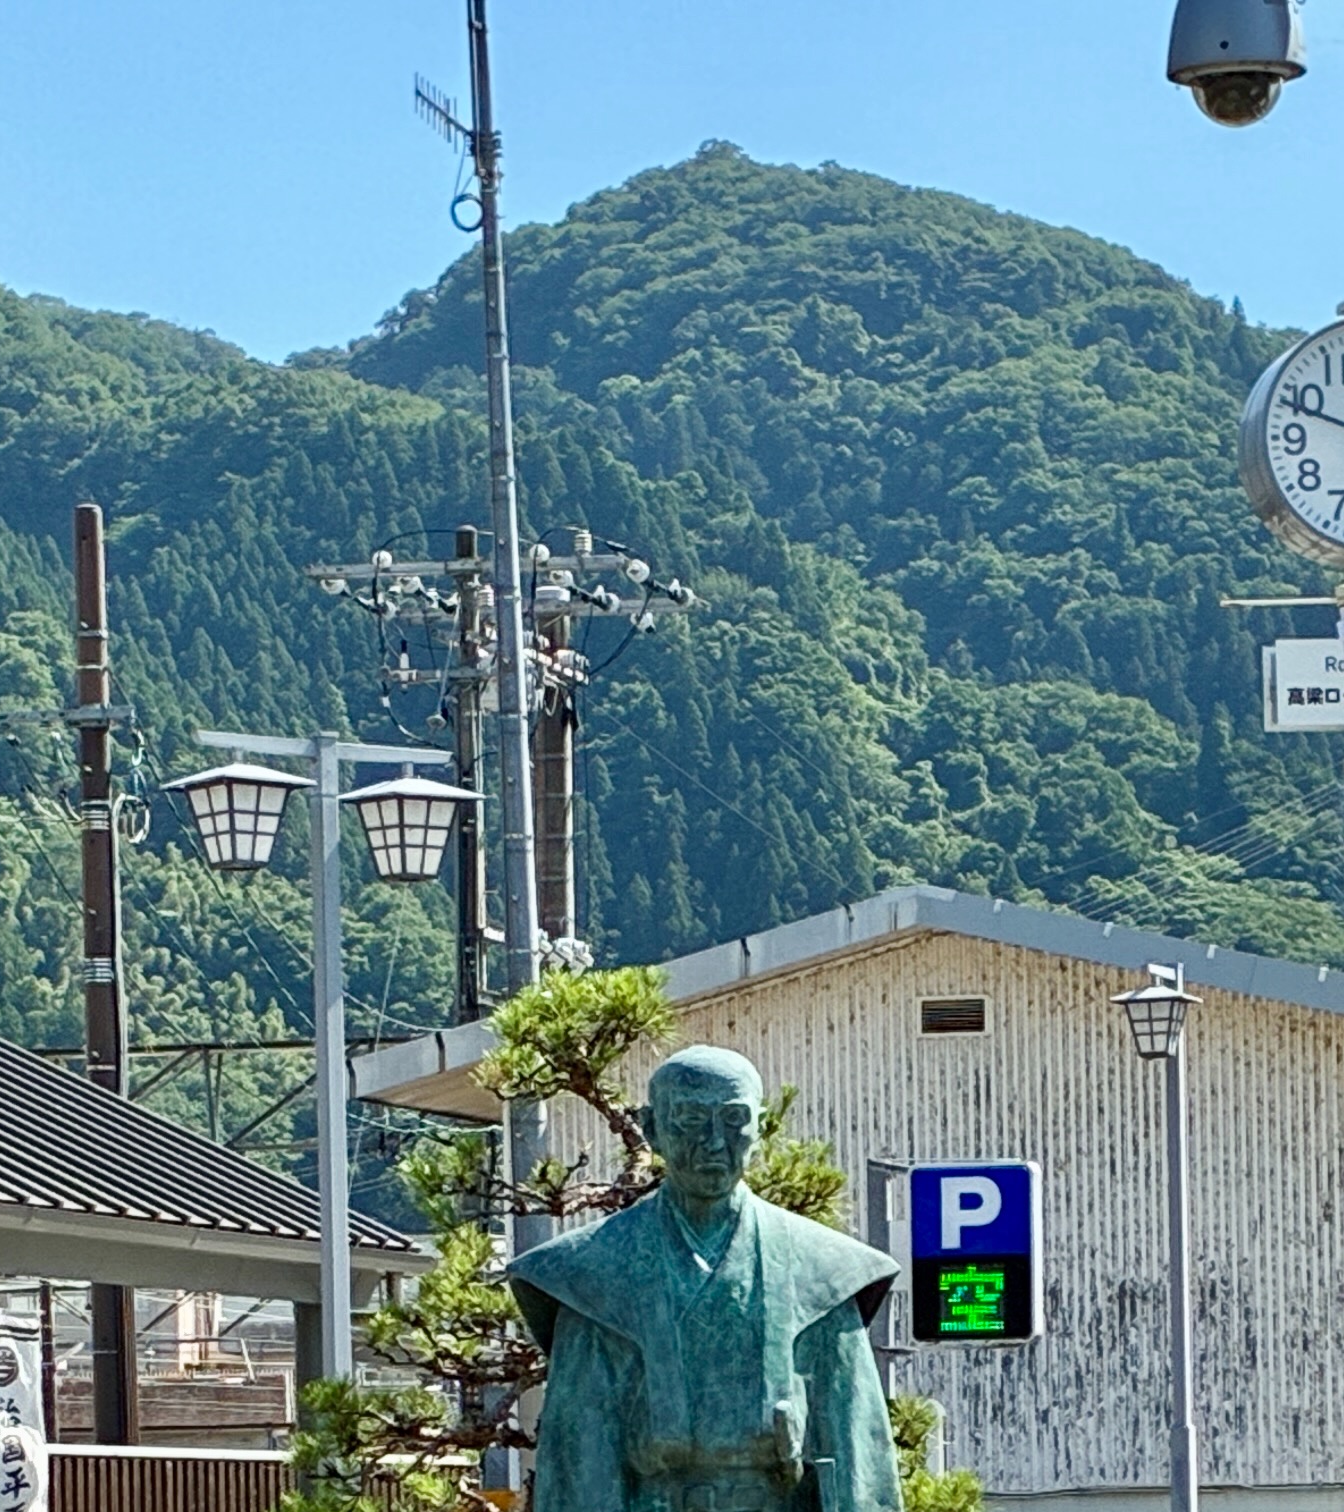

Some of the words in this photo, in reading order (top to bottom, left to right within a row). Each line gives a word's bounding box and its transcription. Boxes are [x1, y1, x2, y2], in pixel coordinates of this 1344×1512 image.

[1283, 422, 1306, 456] 9
[1297, 458, 1322, 492] 8
[940, 1175, 1002, 1249] P
[939, 1265, 1005, 1331] 空
